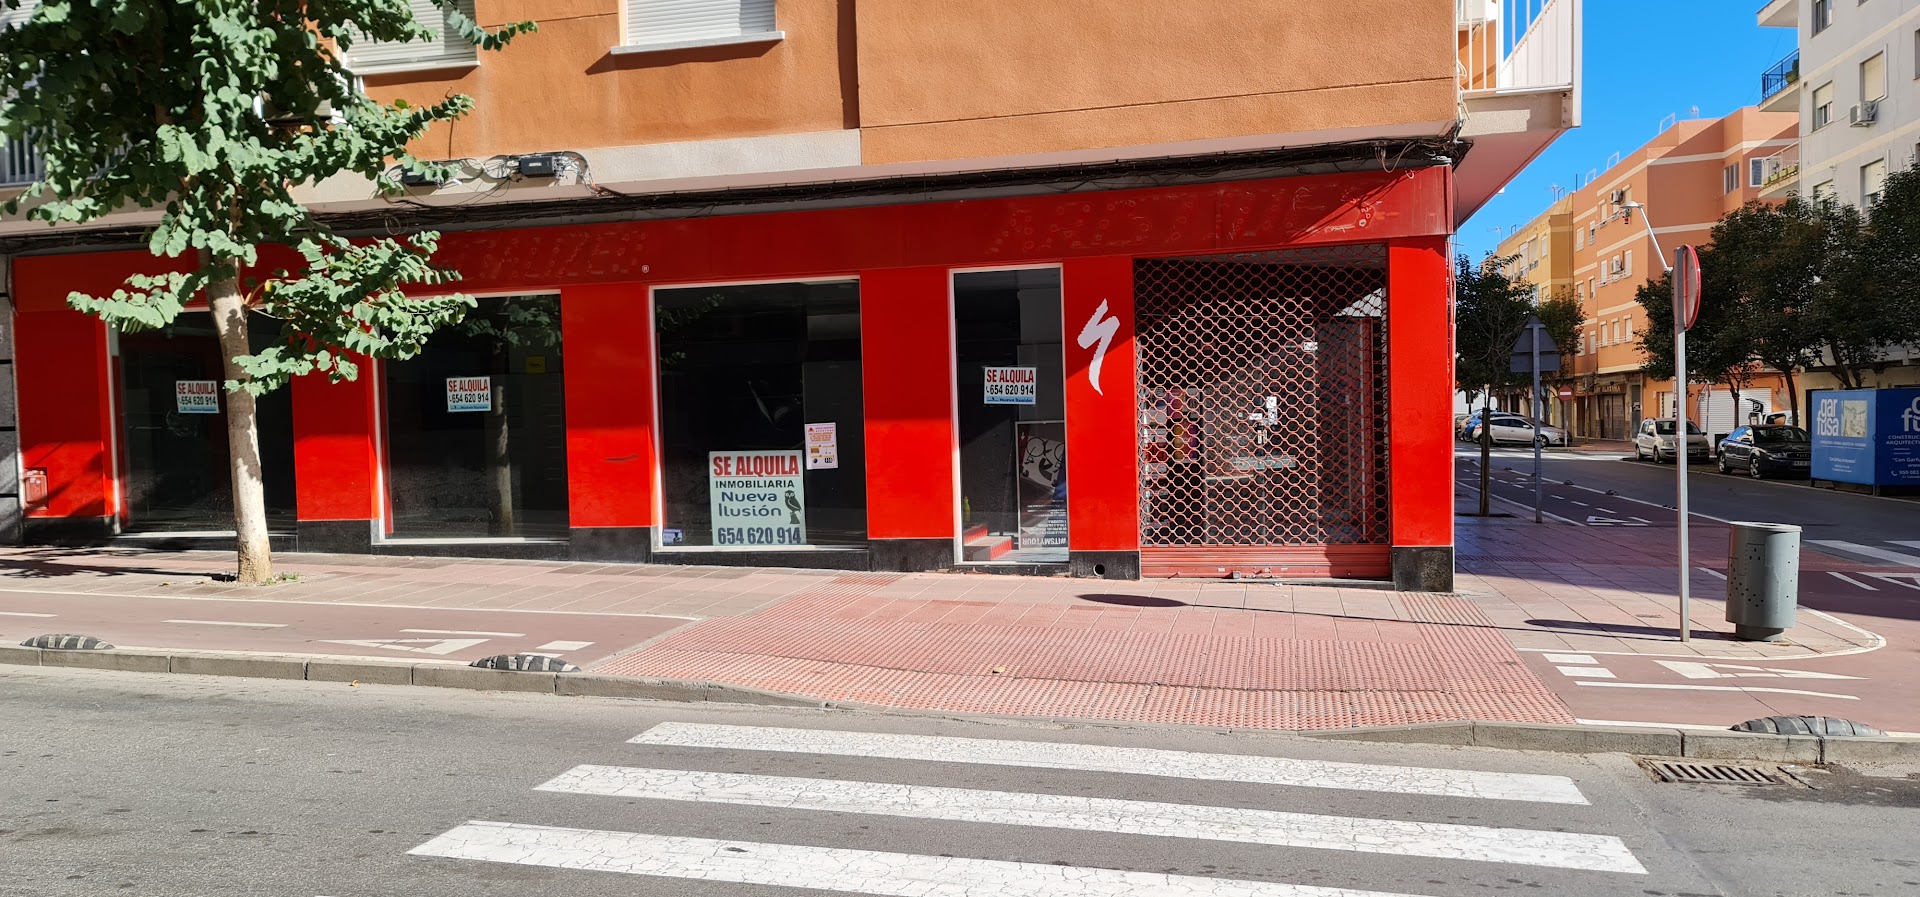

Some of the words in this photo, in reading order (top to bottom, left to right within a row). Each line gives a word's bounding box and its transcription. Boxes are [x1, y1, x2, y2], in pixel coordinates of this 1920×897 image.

[987, 369, 998, 383] SE
[999, 369, 1034, 384] ALQUILA
[178, 382, 186, 394] SE
[188, 382, 215, 395] ALQUILA
[448, 380, 458, 392] SE
[459, 379, 489, 392] ALQUILA
[990, 384, 1003, 395] 654
[1005, 384, 1019, 395] 620
[1020, 384, 1034, 395] 914
[181, 395, 192, 405] 654
[193, 395, 204, 405] 620
[205, 395, 217, 405] 914
[451, 393, 463, 403] 654
[464, 393, 476, 403] 620
[477, 392, 489, 402] 914
[1820, 398, 1838, 424] gar
[1817, 410, 1839, 437] fusa
[713, 456, 732, 476] SE
[735, 455, 800, 477] ALQUILA
[715, 480, 795, 489] INMOBILIARIA
[721, 491, 778, 502] Nueva
[718, 503, 782, 517] Ilusión
[717, 527, 745, 545] 654
[747, 527, 774, 545] 620
[776, 527, 802, 545] 914
[1022, 537, 1067, 546] #ITSMYTOUR
